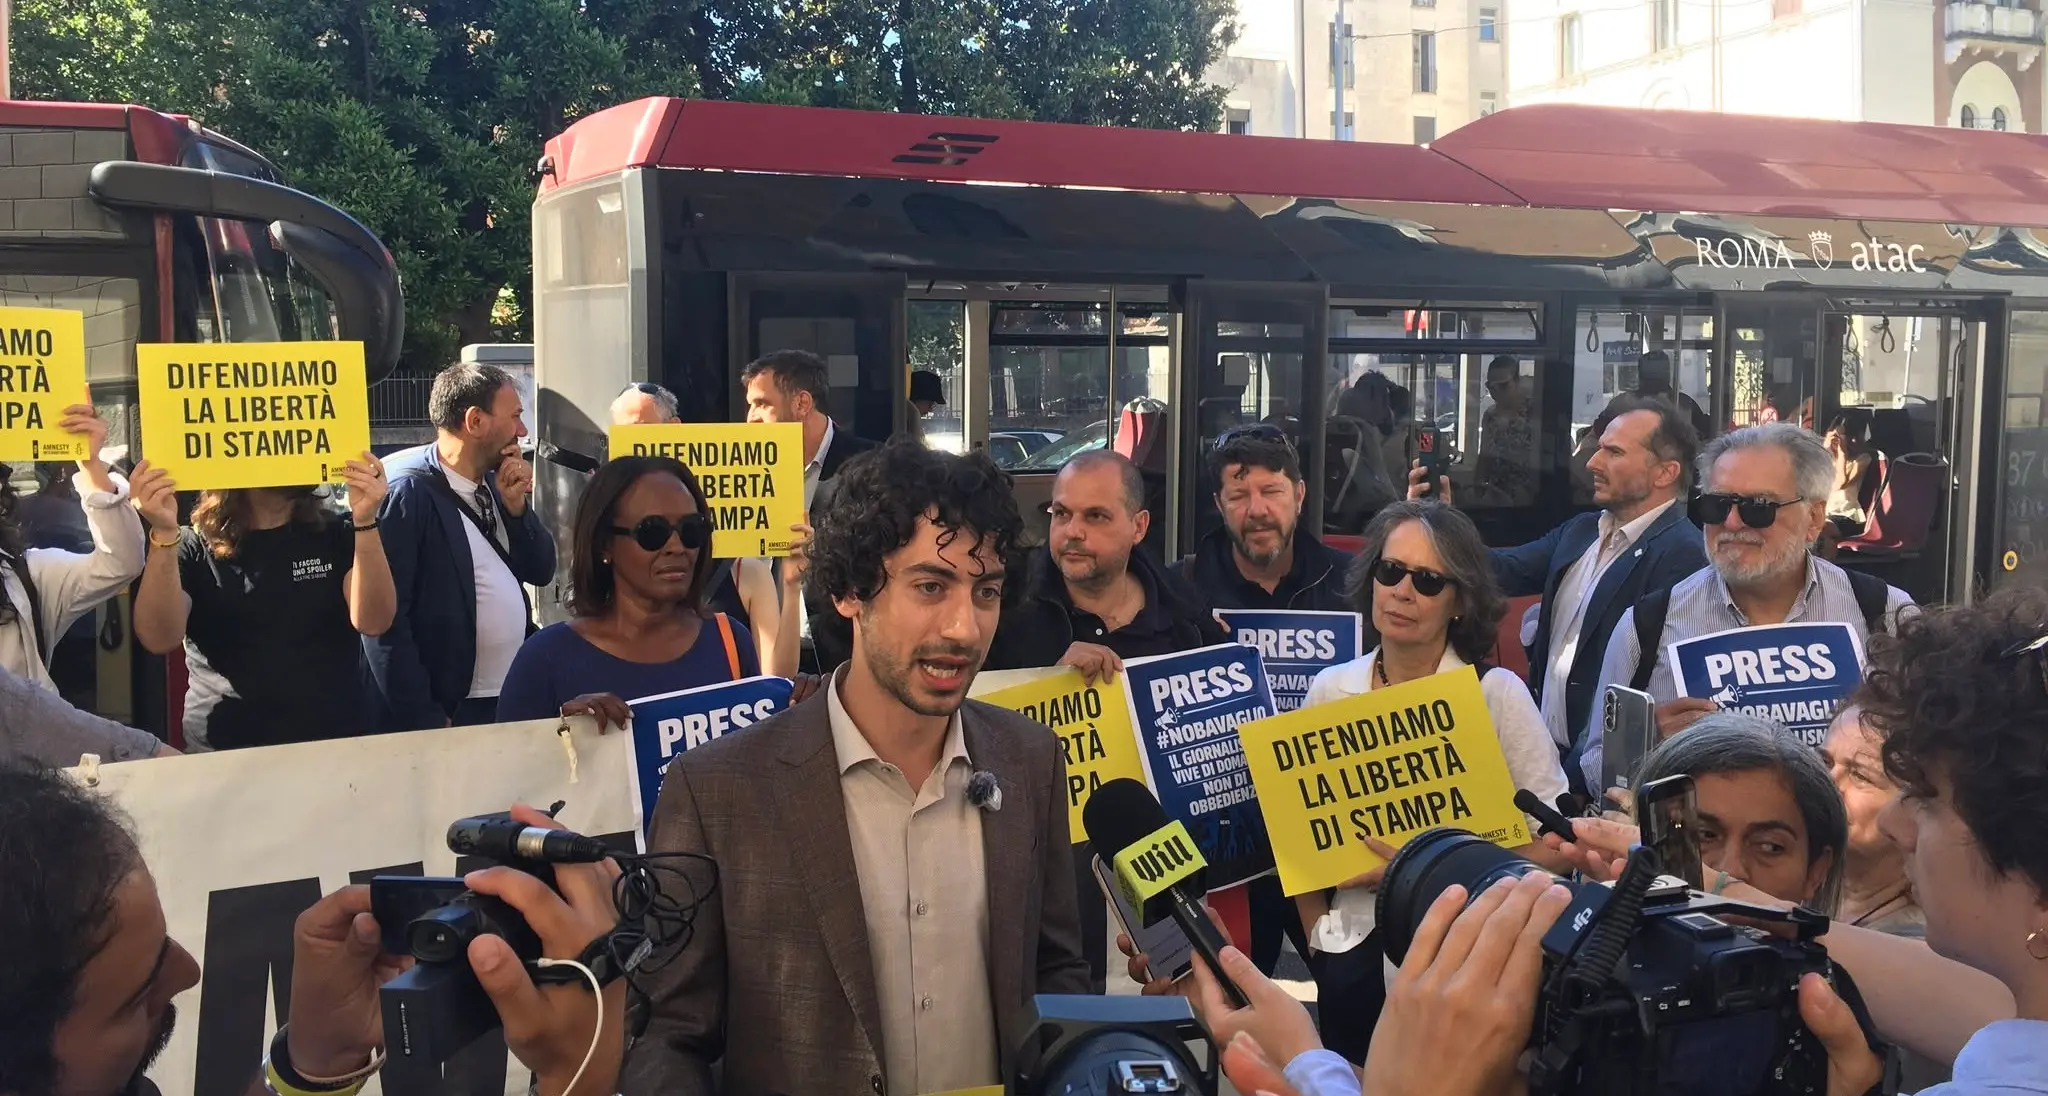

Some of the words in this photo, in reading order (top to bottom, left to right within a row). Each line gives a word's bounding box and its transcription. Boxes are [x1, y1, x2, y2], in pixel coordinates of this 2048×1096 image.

[1694, 237, 1795, 270] ROMA
[1850, 236, 1927, 274] atac
[167, 359, 338, 390] DIFENDIAMO
[0, 402, 44, 429] PA
[183, 397, 216, 424] LA
[224, 388, 337, 423] LIBERTÀ
[43, 443, 70, 451] AMNESTY
[185, 432, 212, 460] DI
[223, 428, 332, 459] STAMPA
[694, 468, 776, 499] BERTÀ
[708, 505, 770, 532] AMPA
[306, 563, 333, 574] SPOILER
[1237, 628, 1336, 660] PRESS
[1704, 643, 1837, 689] PRESS
[1149, 661, 1253, 712] PRESS
[1272, 699, 1455, 772] DIFENDIAMO
[1168, 754, 1182, 770] IL
[1182, 737, 1244, 766] GIORNALIS
[1172, 769, 1201, 785] VIVE
[1203, 763, 1215, 778] DI
[1216, 755, 1248, 776] DOMA
[1203, 775, 1233, 797] NON
[1234, 771, 1248, 787] DI
[1298, 773, 1337, 810] LA
[1340, 736, 1466, 800] LIBERTÀ
[1189, 785, 1257, 816] OBBEDIENZ
[1309, 814, 1344, 851] DI
[1349, 786, 1473, 841] STAMPA
